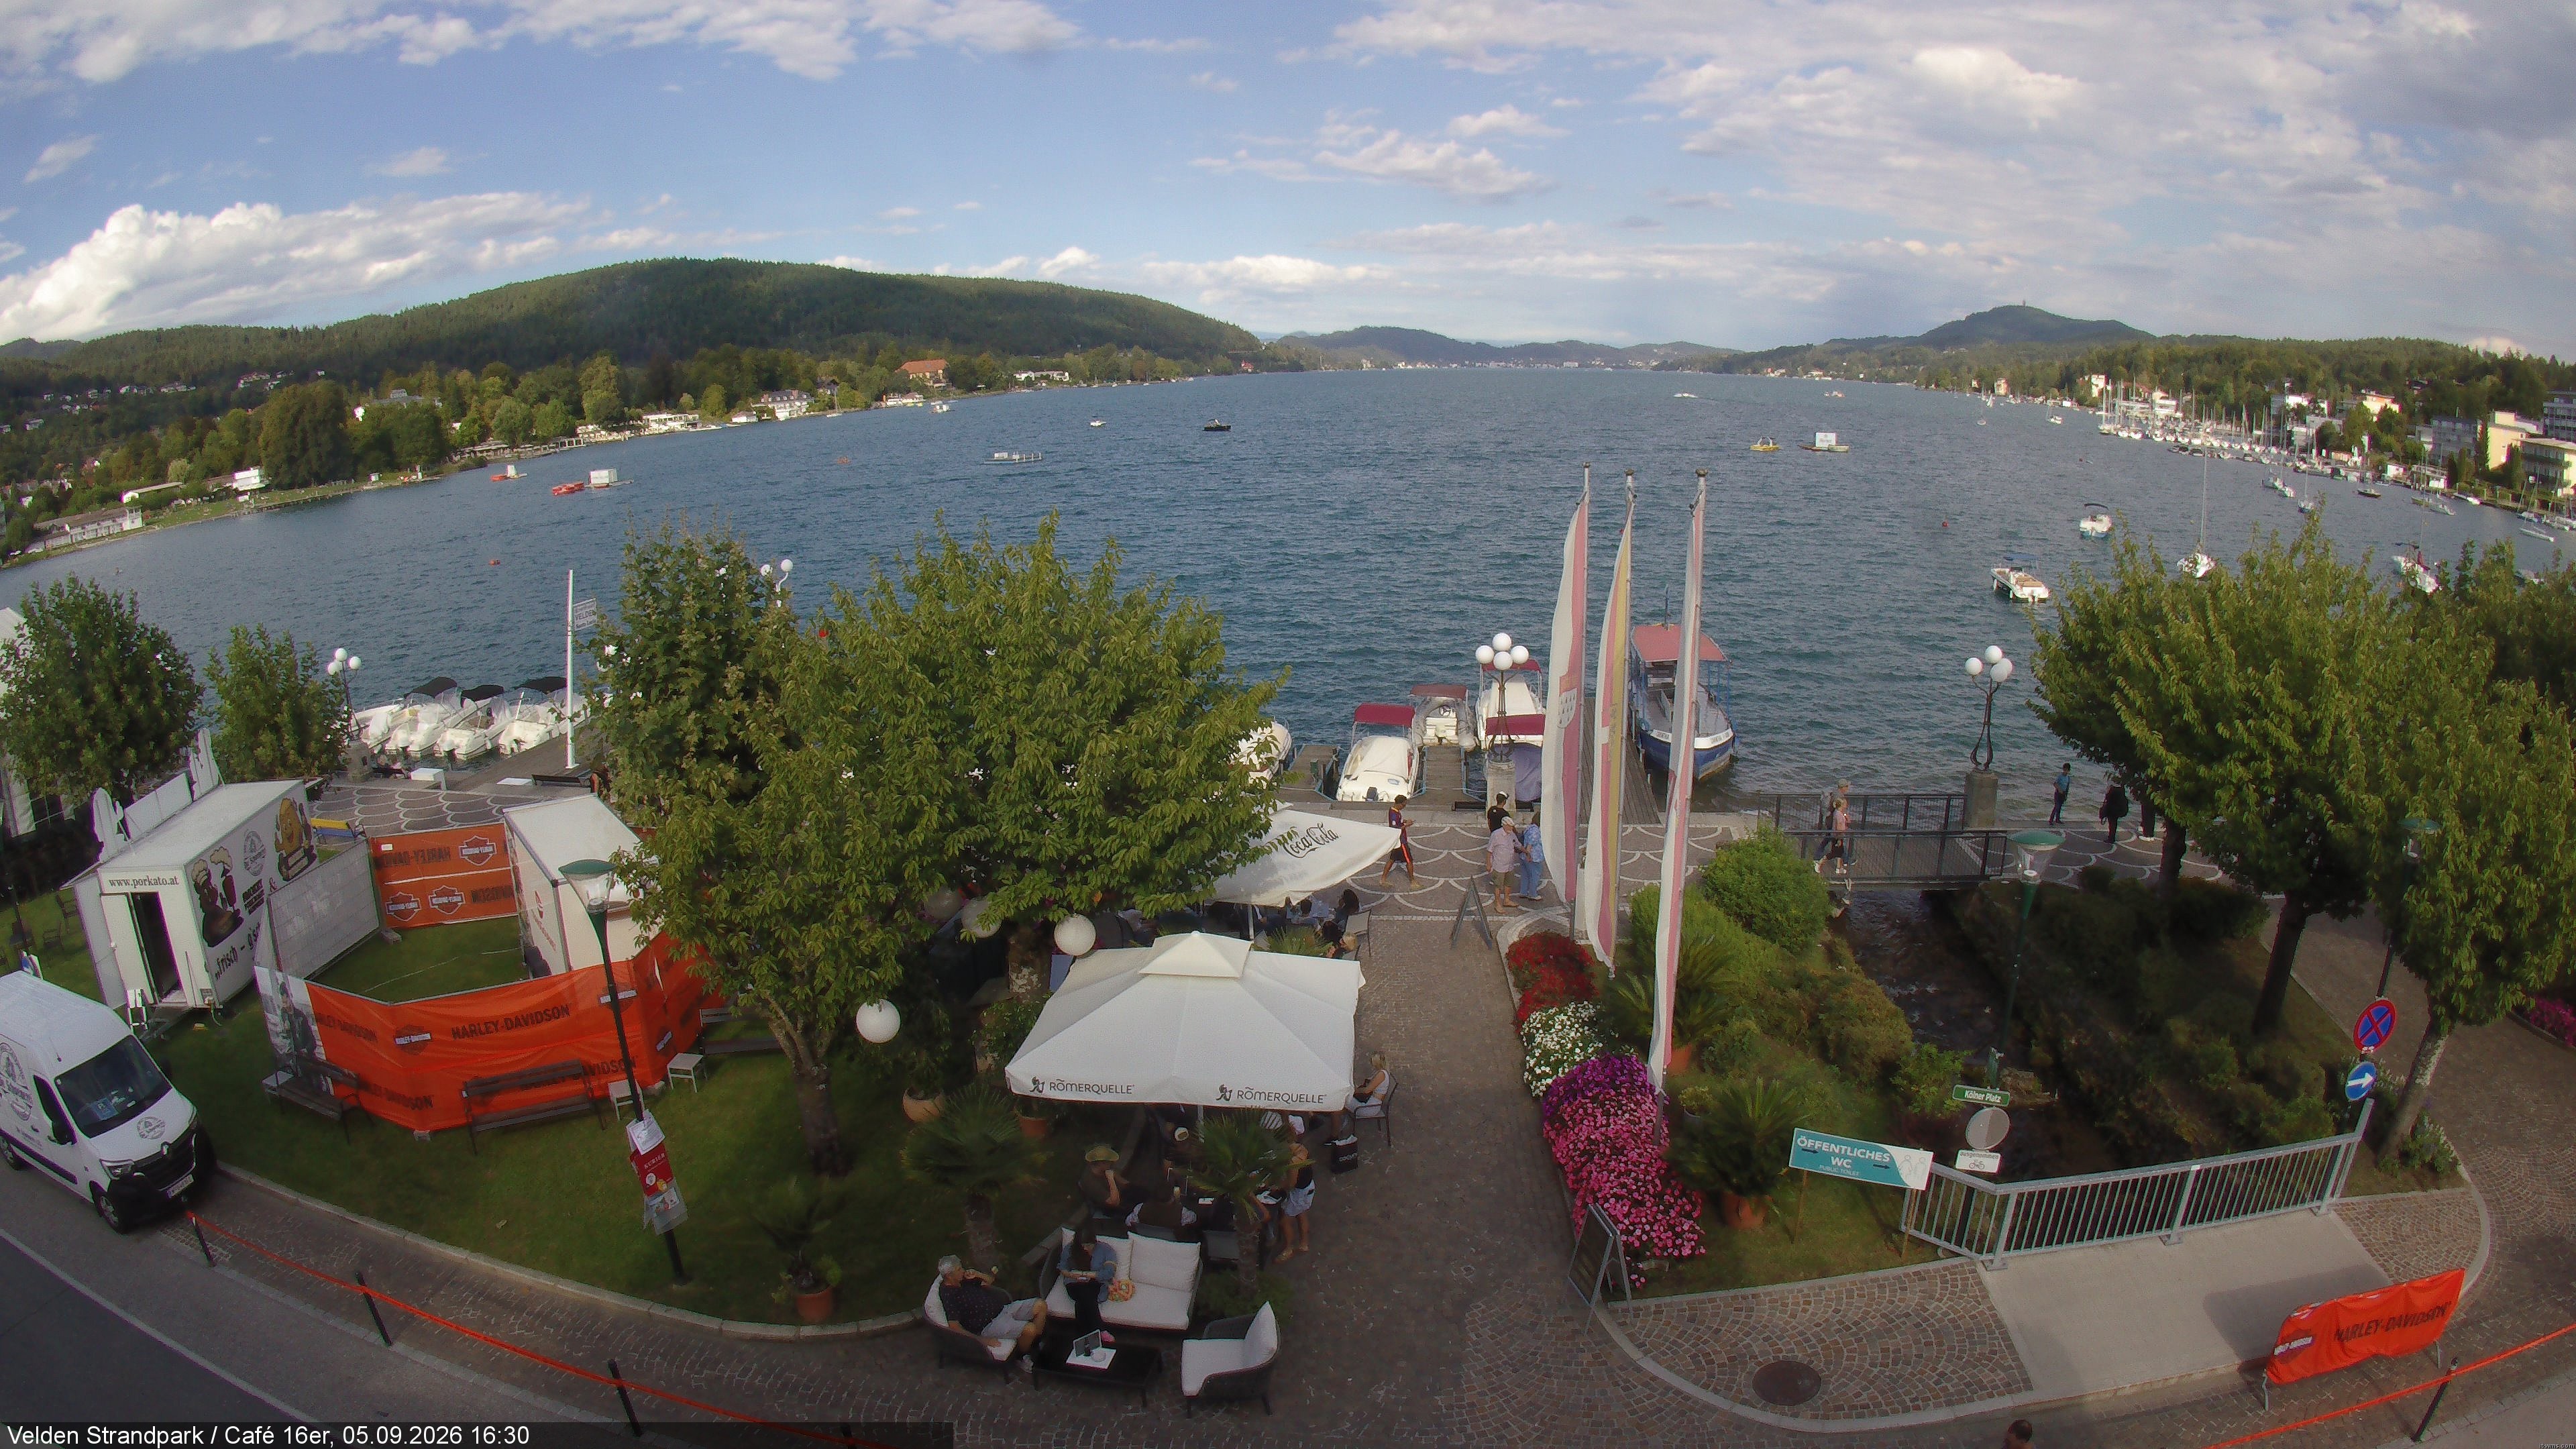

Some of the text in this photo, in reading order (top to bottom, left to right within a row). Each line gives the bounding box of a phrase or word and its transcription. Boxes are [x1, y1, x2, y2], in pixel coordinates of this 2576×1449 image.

[575, 609, 596, 620] VELDE
[109, 875, 179, 888] www.porkato.at
[451, 1005, 570, 1040] HARLEY-DAVIDSON
[1964, 1089, 2002, 1103] Kölner Platz
[1796, 1135, 1890, 1163] ÖFFENTLICHES
[1831, 1156, 1852, 1169] WC
